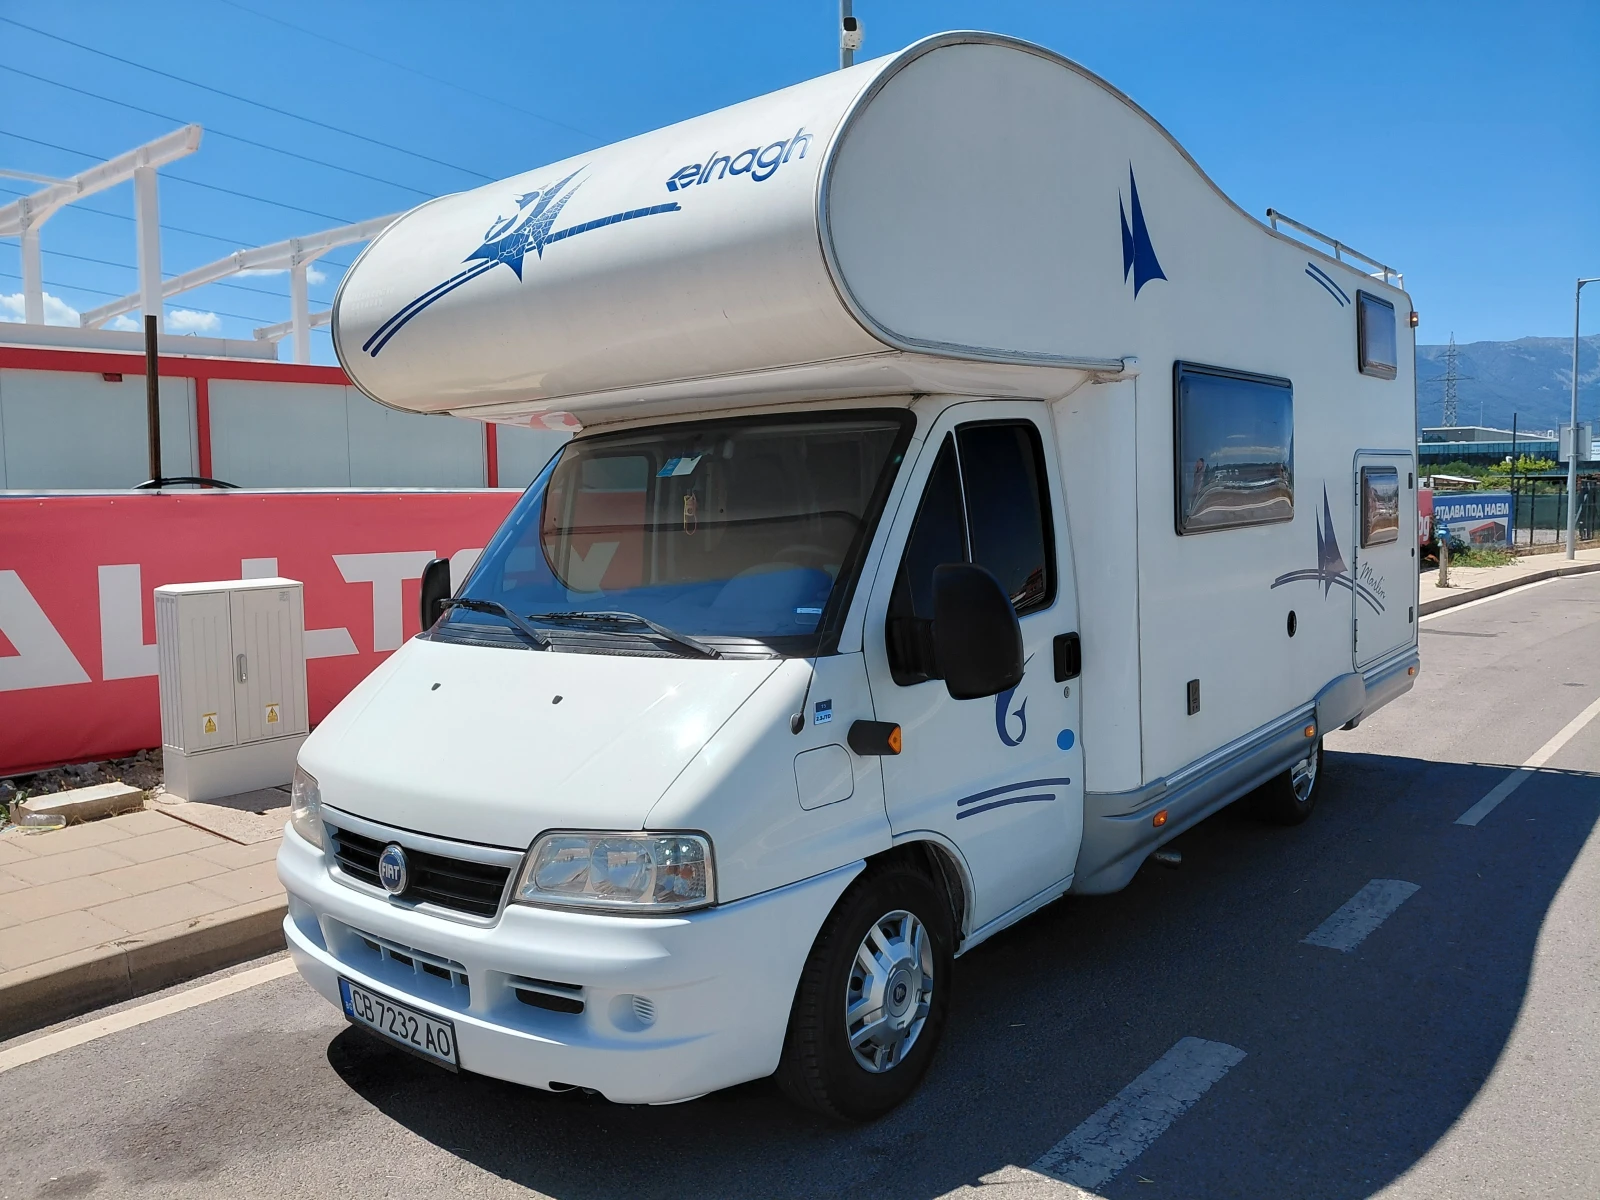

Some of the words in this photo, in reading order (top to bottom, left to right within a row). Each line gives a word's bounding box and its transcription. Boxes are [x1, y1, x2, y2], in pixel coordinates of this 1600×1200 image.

[666, 127, 814, 192] elnagh
[1466, 504, 1484, 518] ПОД
[1484, 503, 1508, 516] НАЕМ
[381, 861, 400, 880] FIAT
